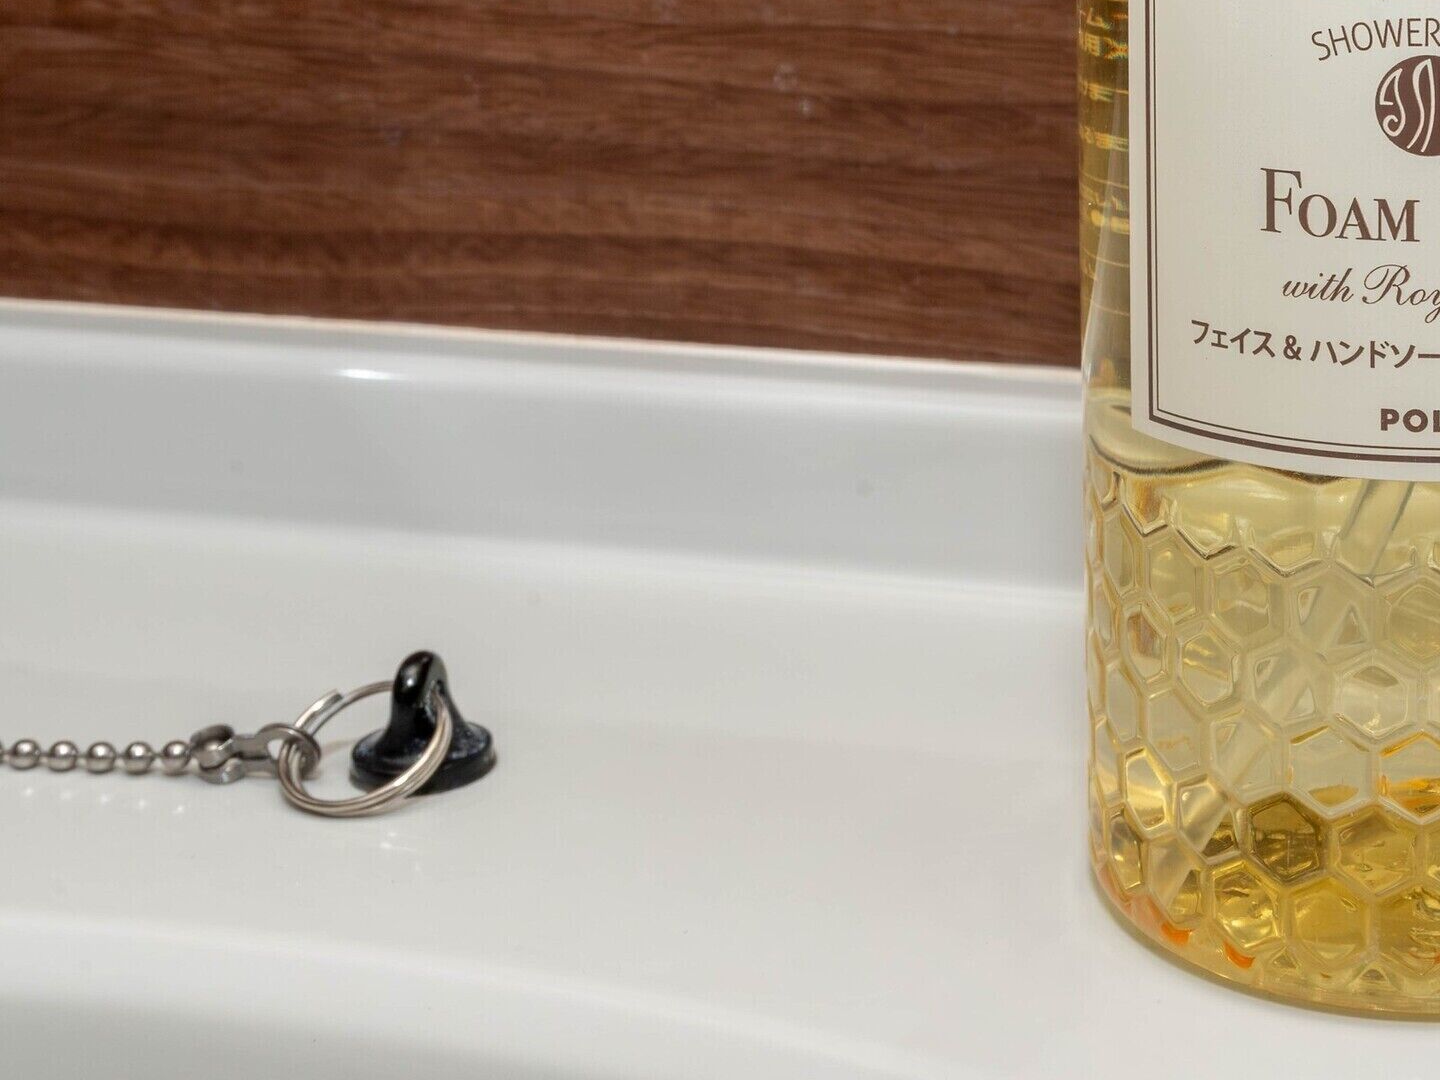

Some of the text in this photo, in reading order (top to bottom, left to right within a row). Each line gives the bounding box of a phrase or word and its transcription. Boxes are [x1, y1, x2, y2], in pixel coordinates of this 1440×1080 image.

[1260, 167, 1421, 243] FOAM
[1282, 267, 1355, 303] with
[1191, 319, 1276, 359] フェイス
[1282, 334, 1302, 361] &
